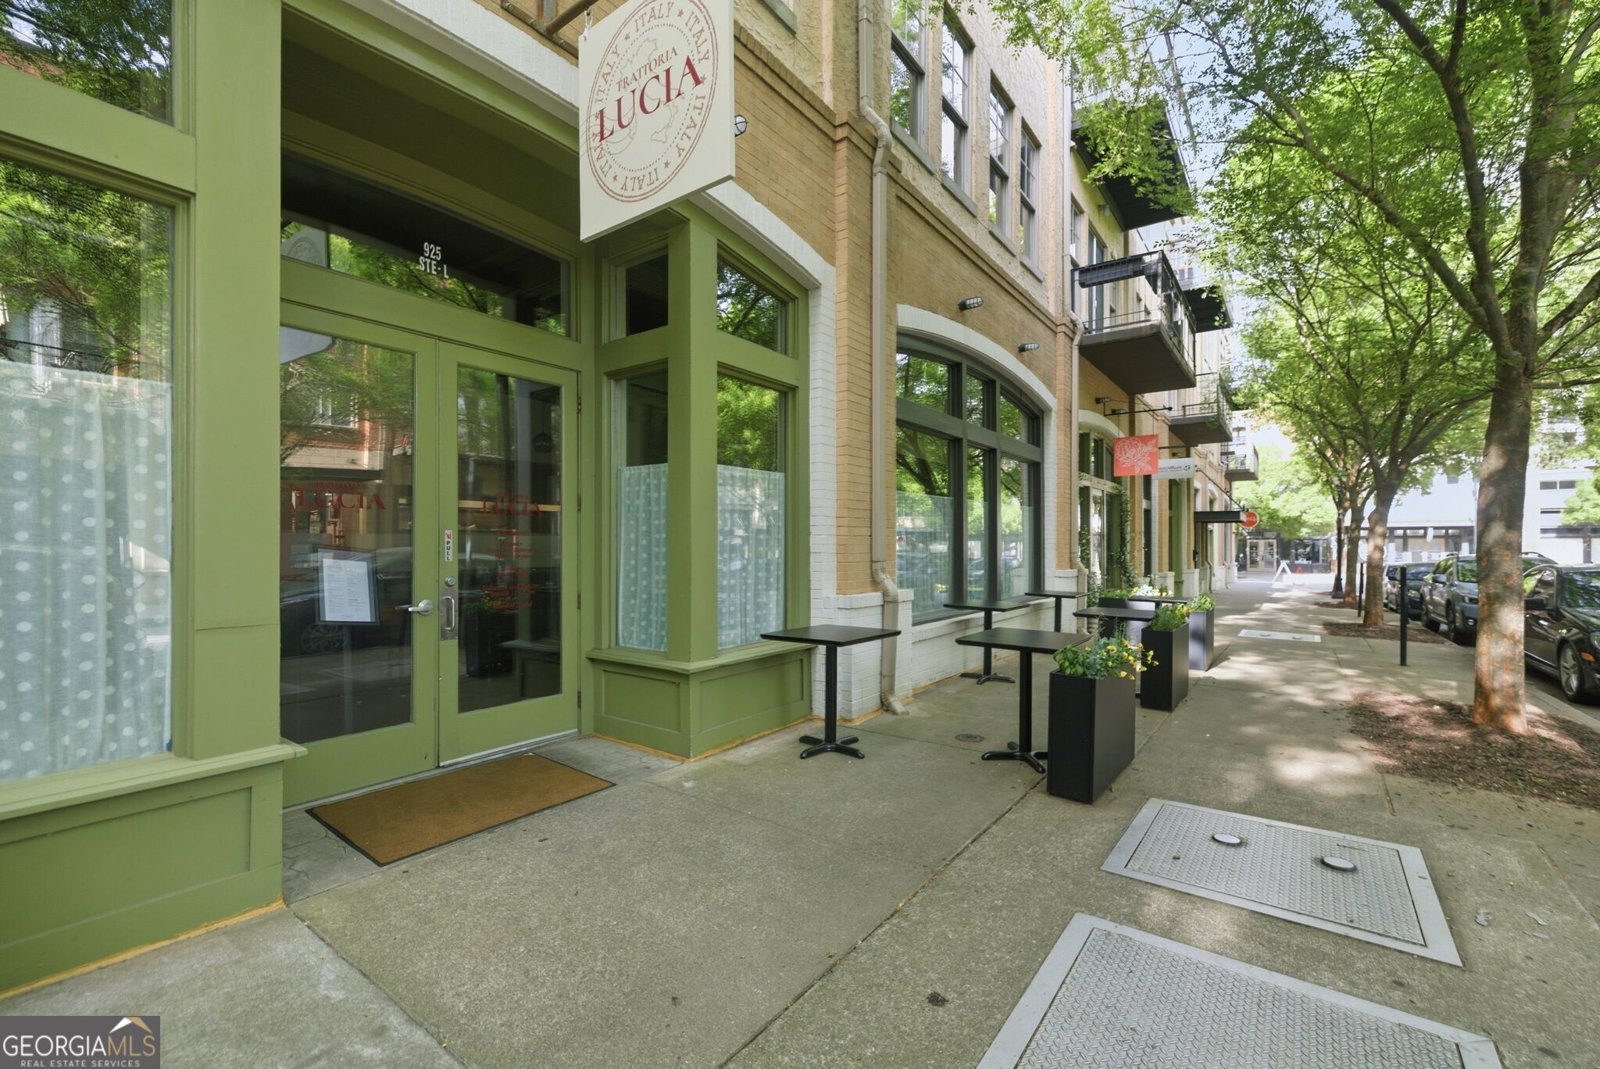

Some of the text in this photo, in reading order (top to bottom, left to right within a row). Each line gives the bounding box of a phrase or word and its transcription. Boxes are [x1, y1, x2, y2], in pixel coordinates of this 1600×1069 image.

[634, 2, 674, 33] ITALY
[684, 11, 710, 64] ITALY
[595, 45, 621, 104] ITALY
[616, 46, 679, 93] TRATTORIA
[593, 55, 704, 143] LUCIA
[677, 94, 706, 158] ITALY
[620, 172, 660, 192] ITALY
[423, 242, 442, 261] 925
[443, 264, 449, 279] L
